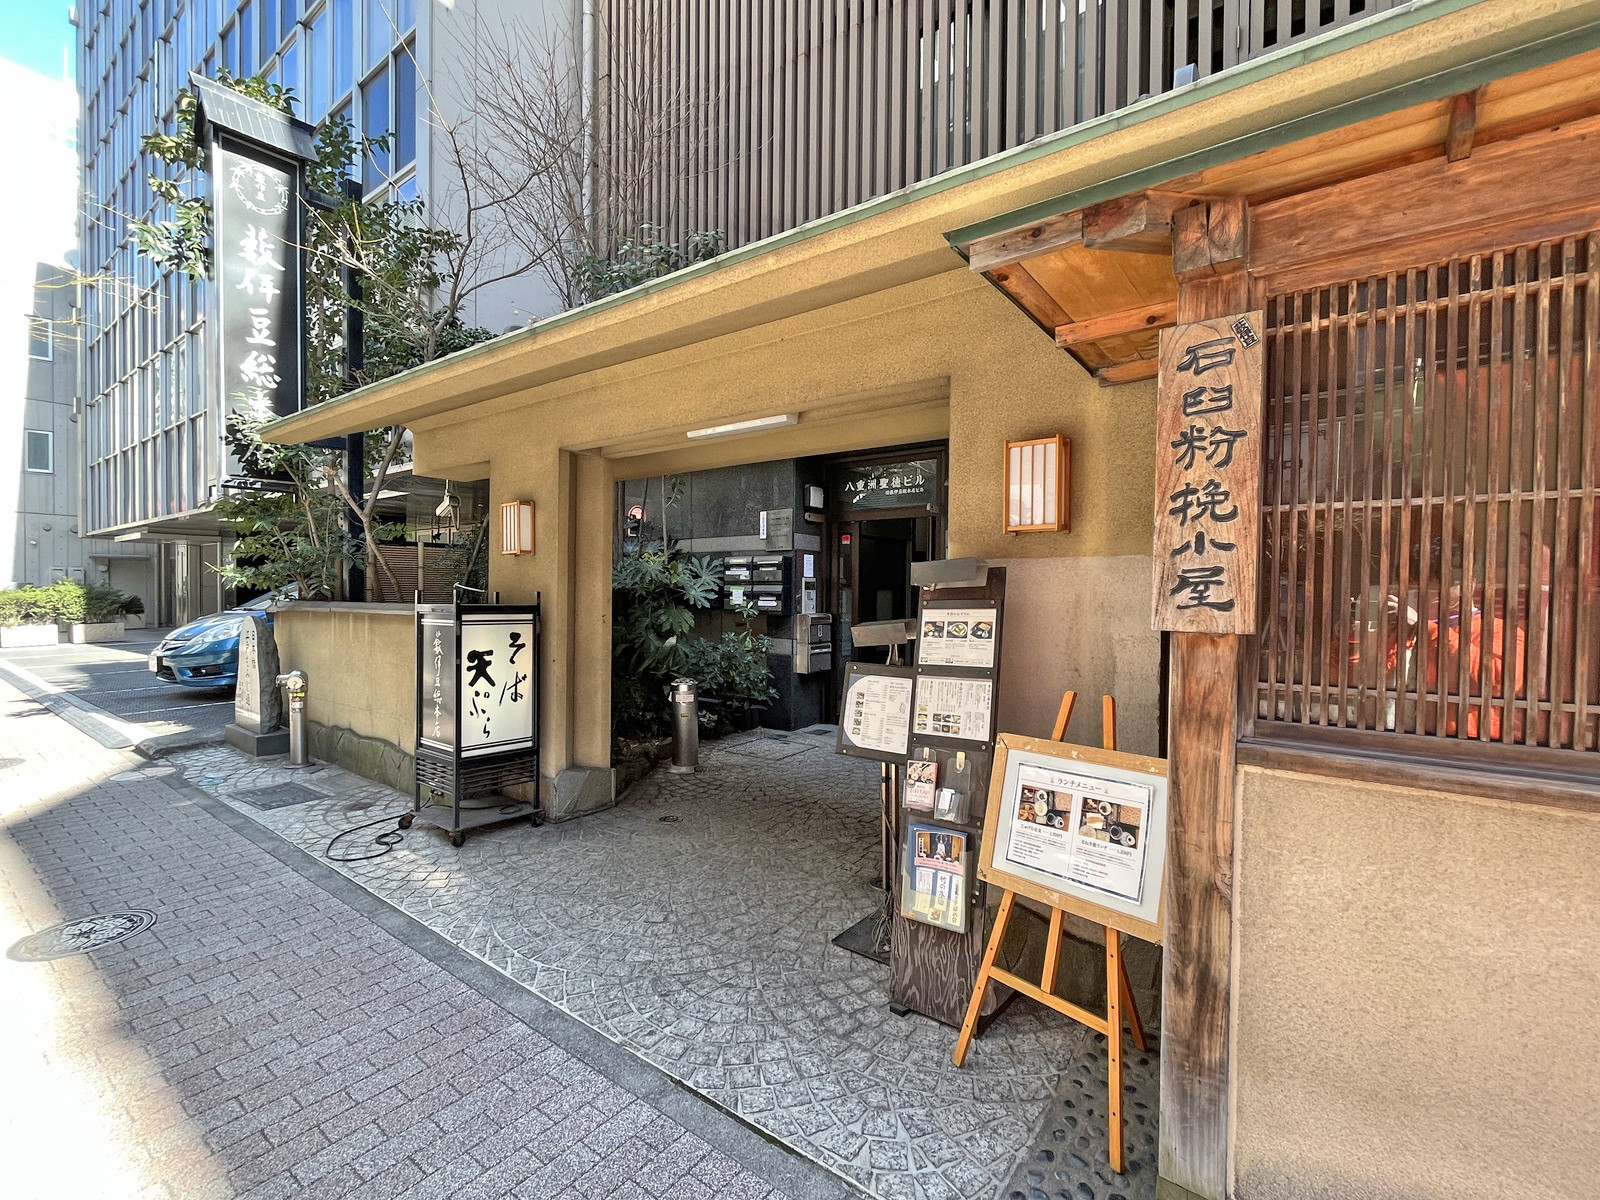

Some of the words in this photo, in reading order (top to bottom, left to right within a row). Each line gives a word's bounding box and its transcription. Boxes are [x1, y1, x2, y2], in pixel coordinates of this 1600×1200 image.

[845, 475, 925, 492] 八重洲聖徳ビル
[1169, 336, 1248, 612] 石臼粉挽小屋
[466, 650, 496, 738] 天ぷら
[498, 632, 527, 706] そば
[1058, 778, 1102, 791] ランチメニュー
